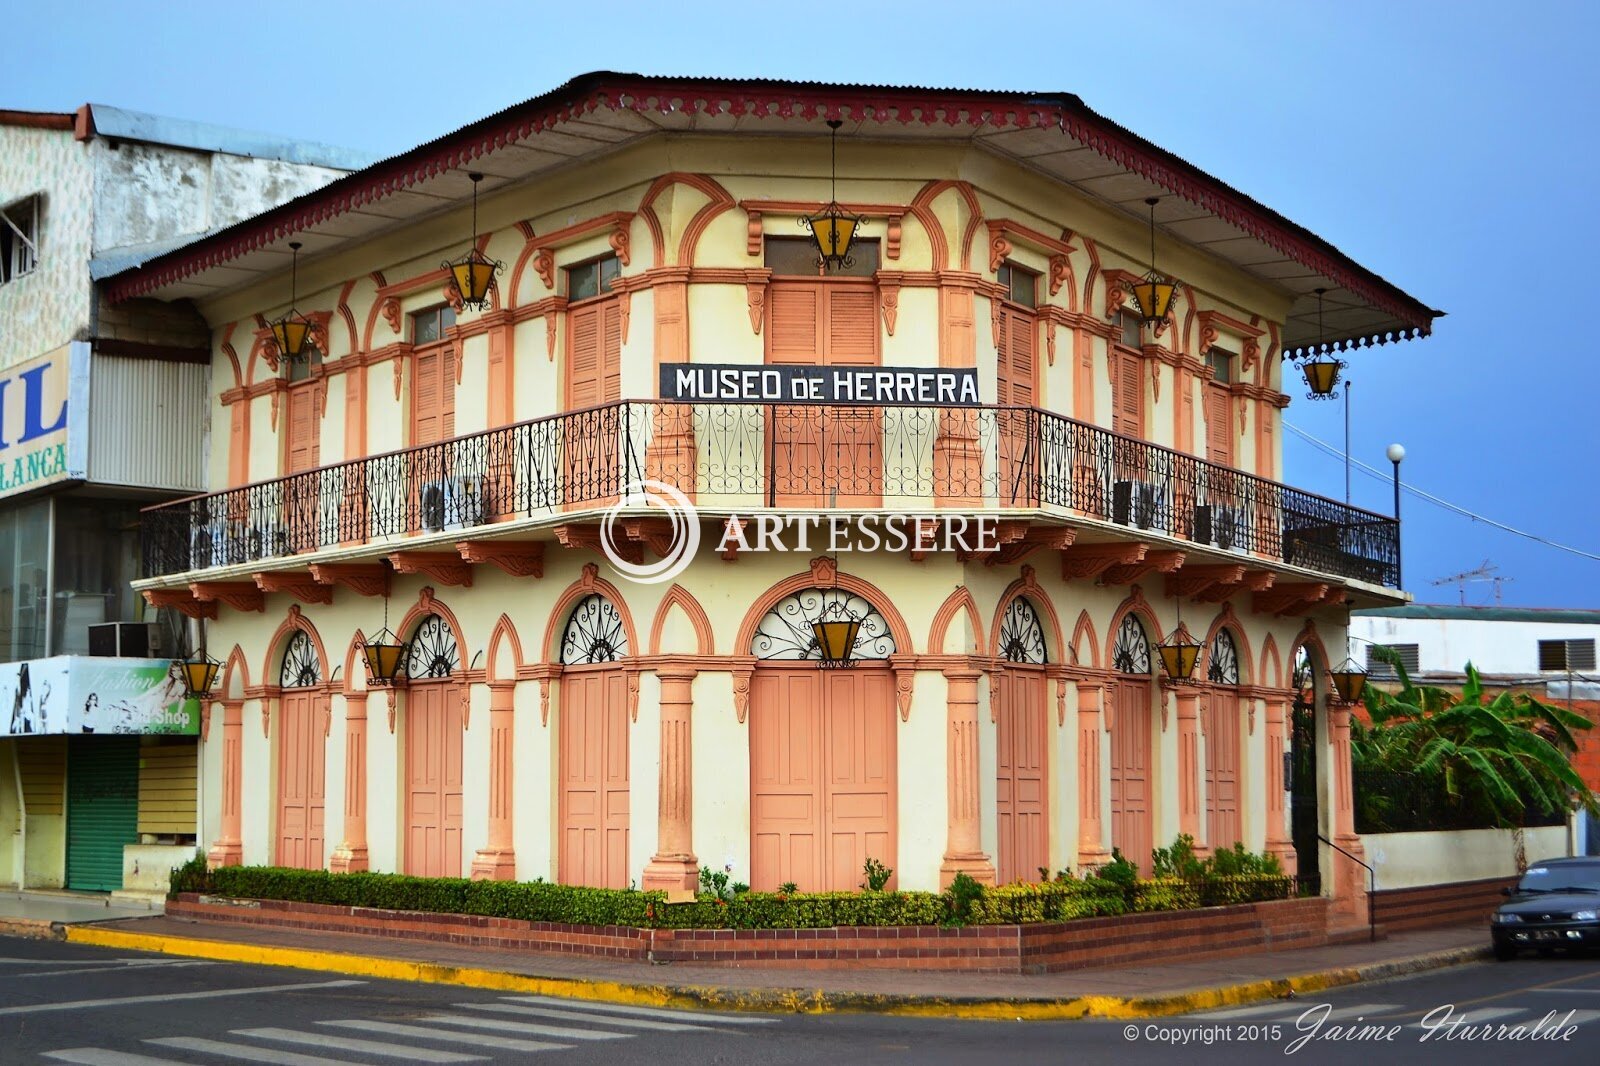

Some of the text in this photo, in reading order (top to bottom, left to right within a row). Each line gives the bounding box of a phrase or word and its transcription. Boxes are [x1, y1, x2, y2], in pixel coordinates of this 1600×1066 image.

[676, 369, 782, 399] MUSEO
[833, 371, 978, 403] HERRERA
[89, 669, 156, 690] Fashion
[157, 707, 190, 729] Shop
